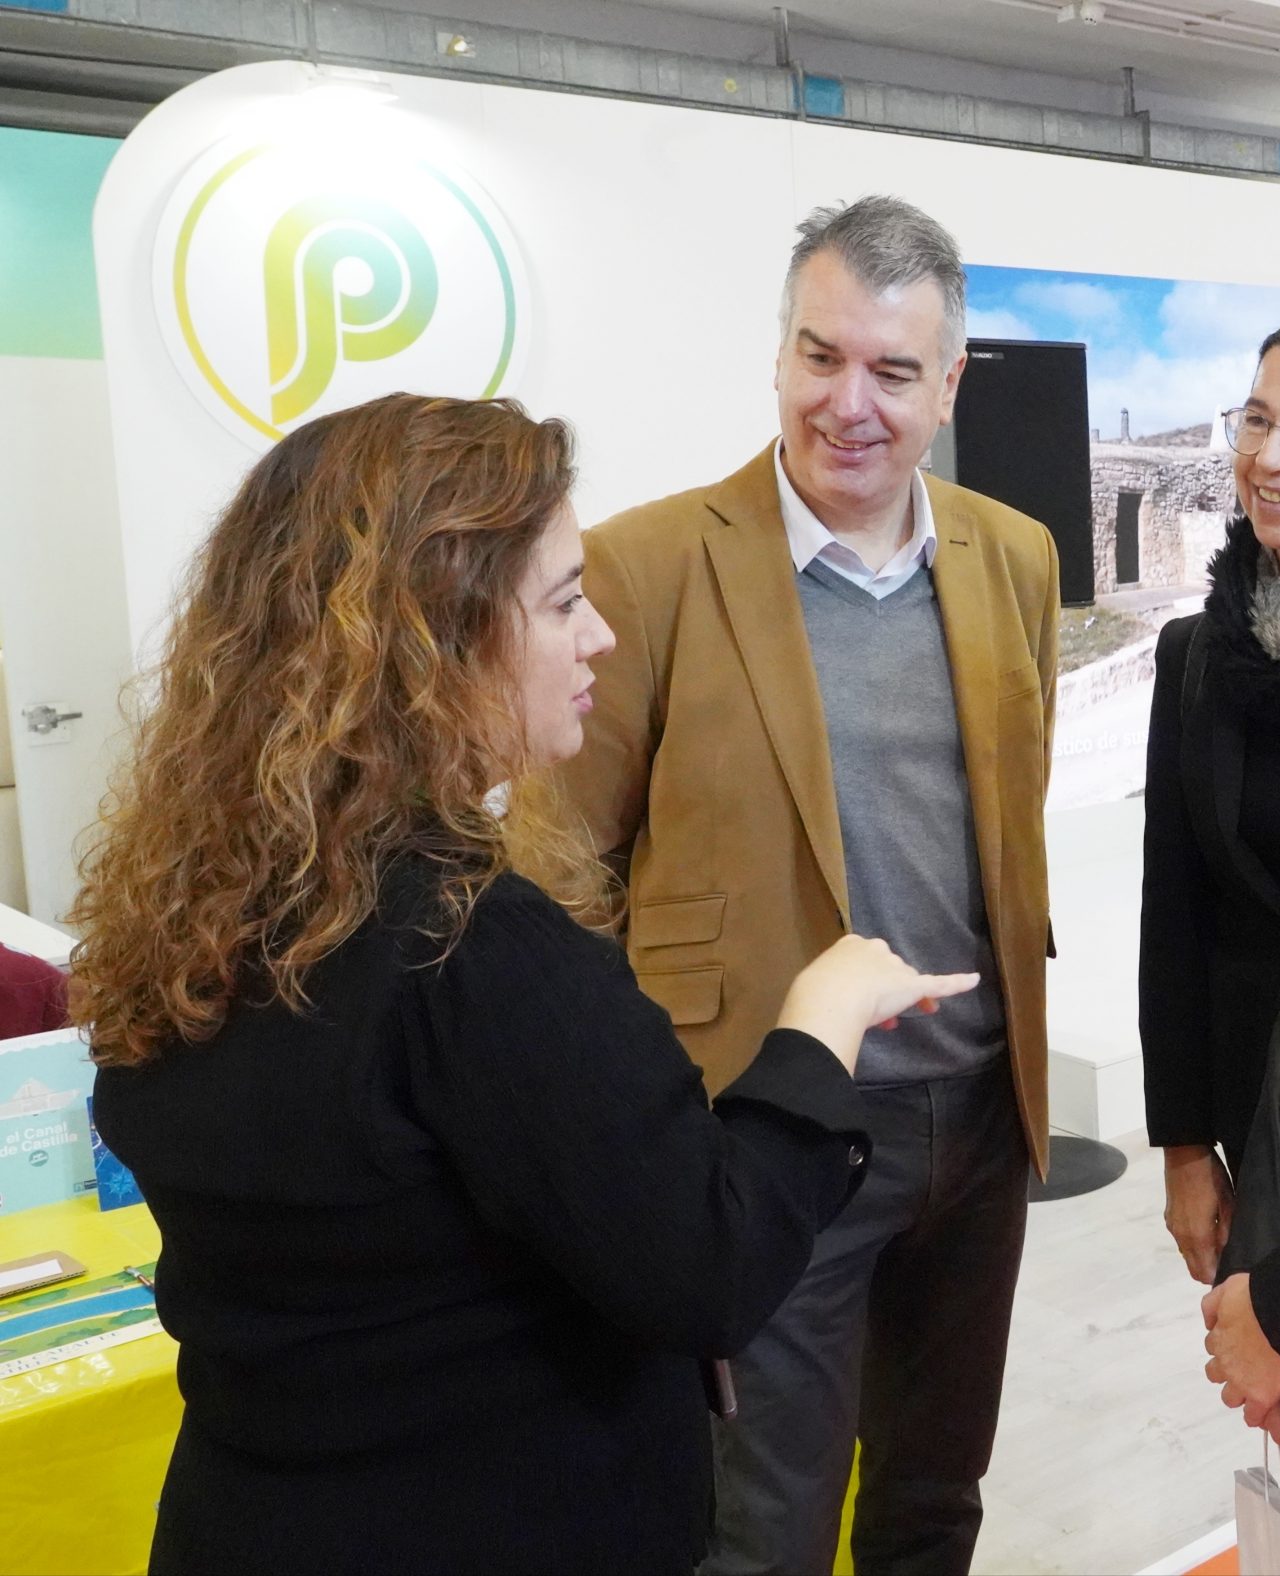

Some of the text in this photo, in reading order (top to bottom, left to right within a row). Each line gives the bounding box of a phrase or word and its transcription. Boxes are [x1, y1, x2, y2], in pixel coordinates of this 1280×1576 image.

[1098, 729, 1118, 749] de
[6, 1121, 68, 1144] el Canal
[21, 1132, 78, 1152] Castilla
